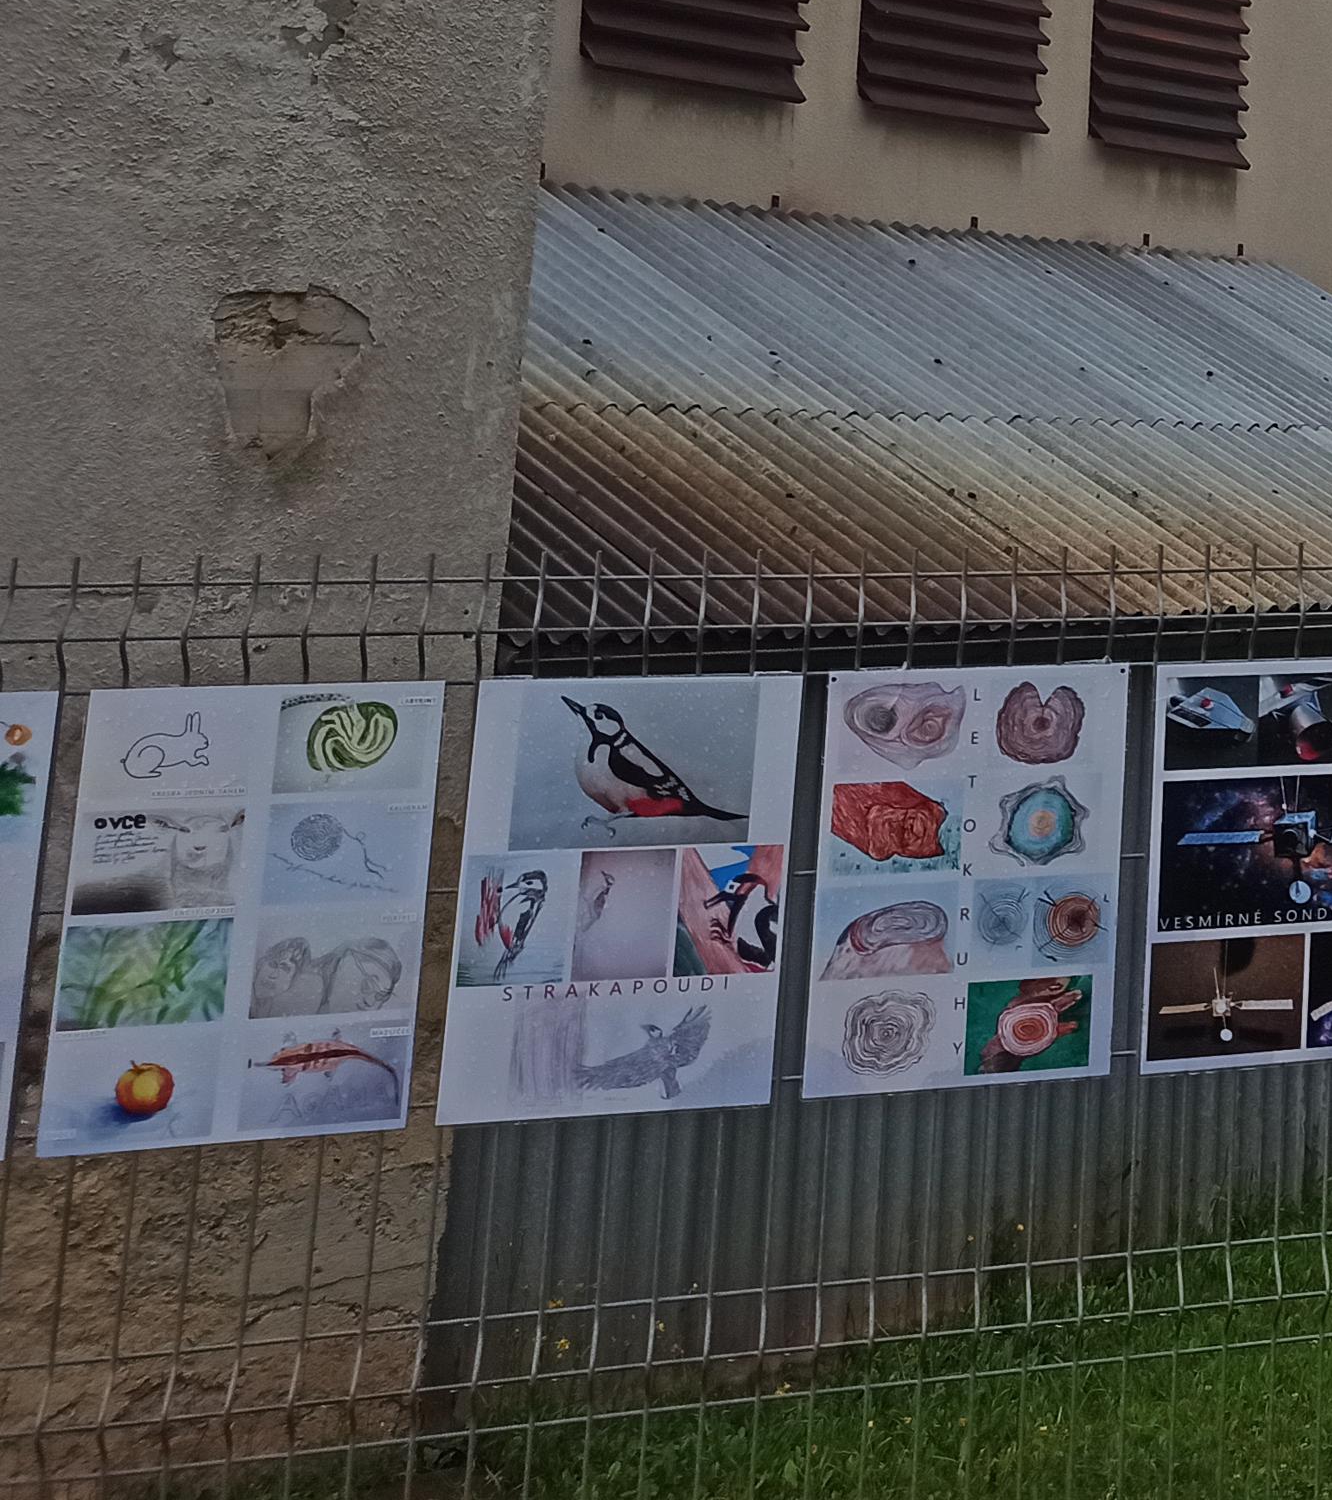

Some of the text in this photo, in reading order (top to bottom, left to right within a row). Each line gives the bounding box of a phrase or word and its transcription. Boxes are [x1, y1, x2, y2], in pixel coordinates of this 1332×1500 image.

[94, 813, 147, 830] ovce
[1159, 909, 1262, 930] VESMÍRNÉ
[503, 975, 729, 1002] STRAKAPOUDI
